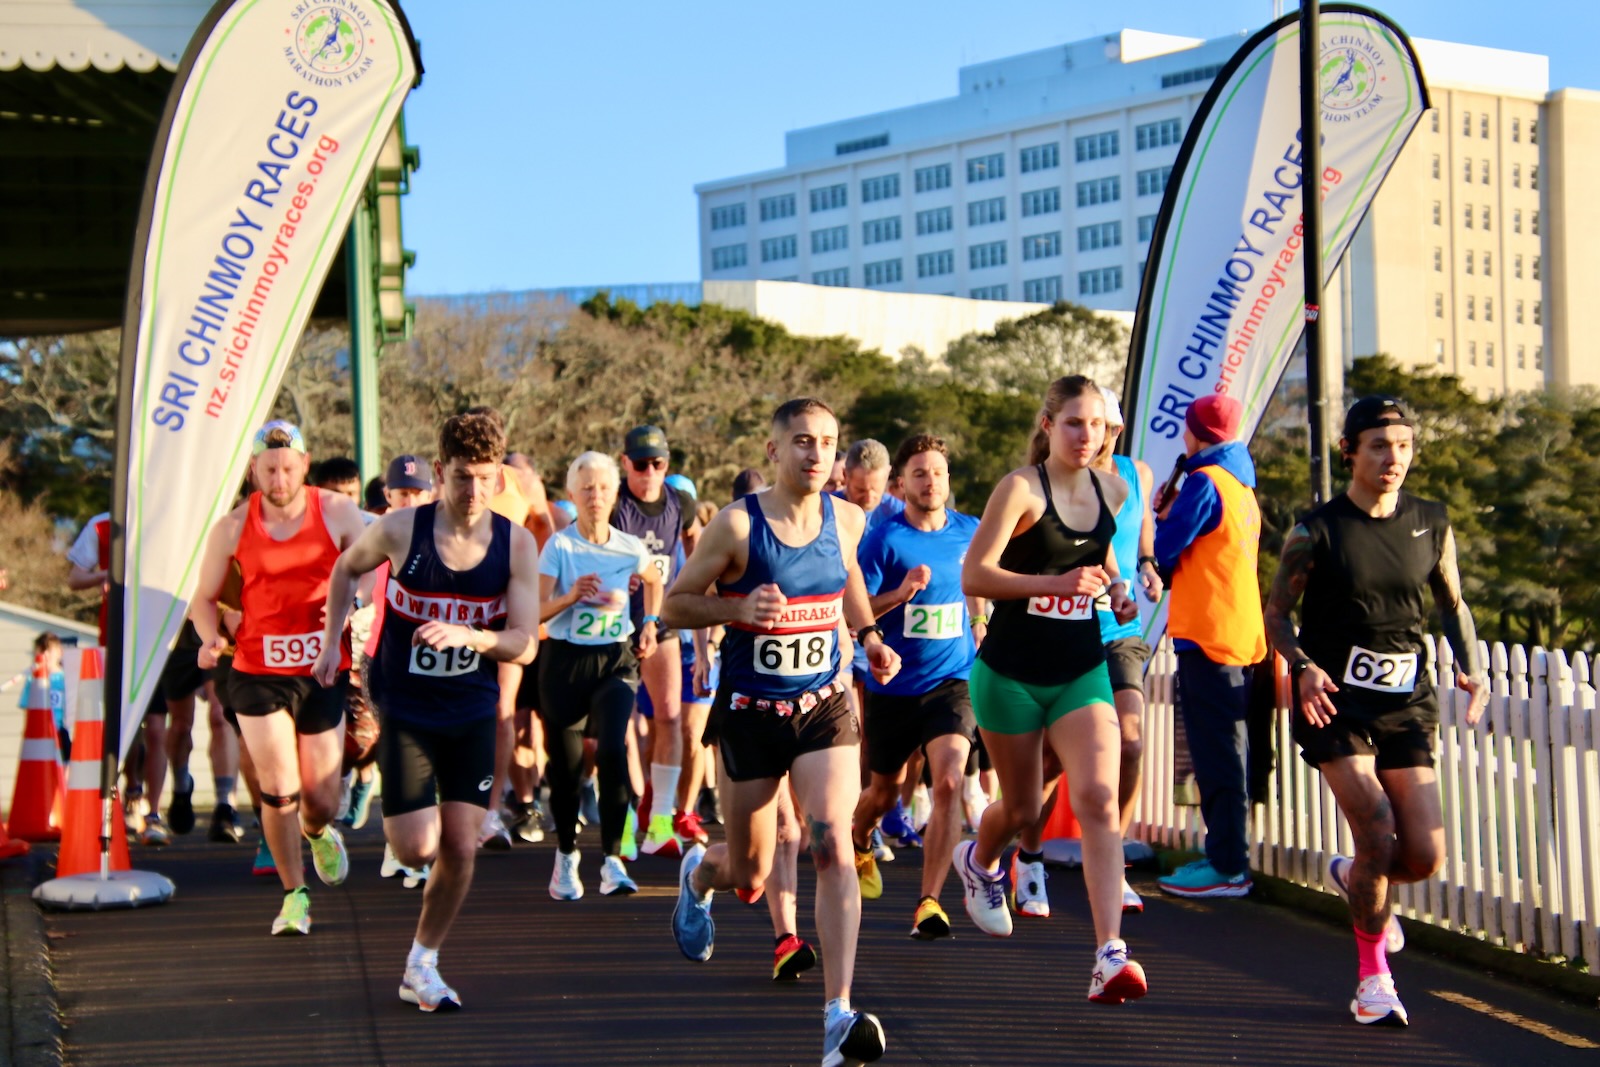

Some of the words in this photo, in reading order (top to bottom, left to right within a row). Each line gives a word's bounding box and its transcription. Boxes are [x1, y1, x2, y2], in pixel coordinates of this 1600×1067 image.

[283, 46, 343, 88] MARATHON
[344, 57, 374, 84] TEAM
[1330, 35, 1386, 67] CHINMOY
[1354, 93, 1384, 119] TEAM
[153, 371, 200, 432] SRI
[178, 208, 264, 367] CHINMOY
[245, 91, 319, 208] RACES
[204, 134, 340, 420] nz.srichinmoyraces.org
[1149, 383, 1196, 440] SRI
[1178, 234, 1265, 381] CHINMOY
[575, 611, 623, 638] 215
[910, 606, 958, 635] 214
[269, 635, 322, 664] 593
[415, 643, 477, 672] 619
[759, 636, 826, 670] 618
[1351, 652, 1414, 687] 627
